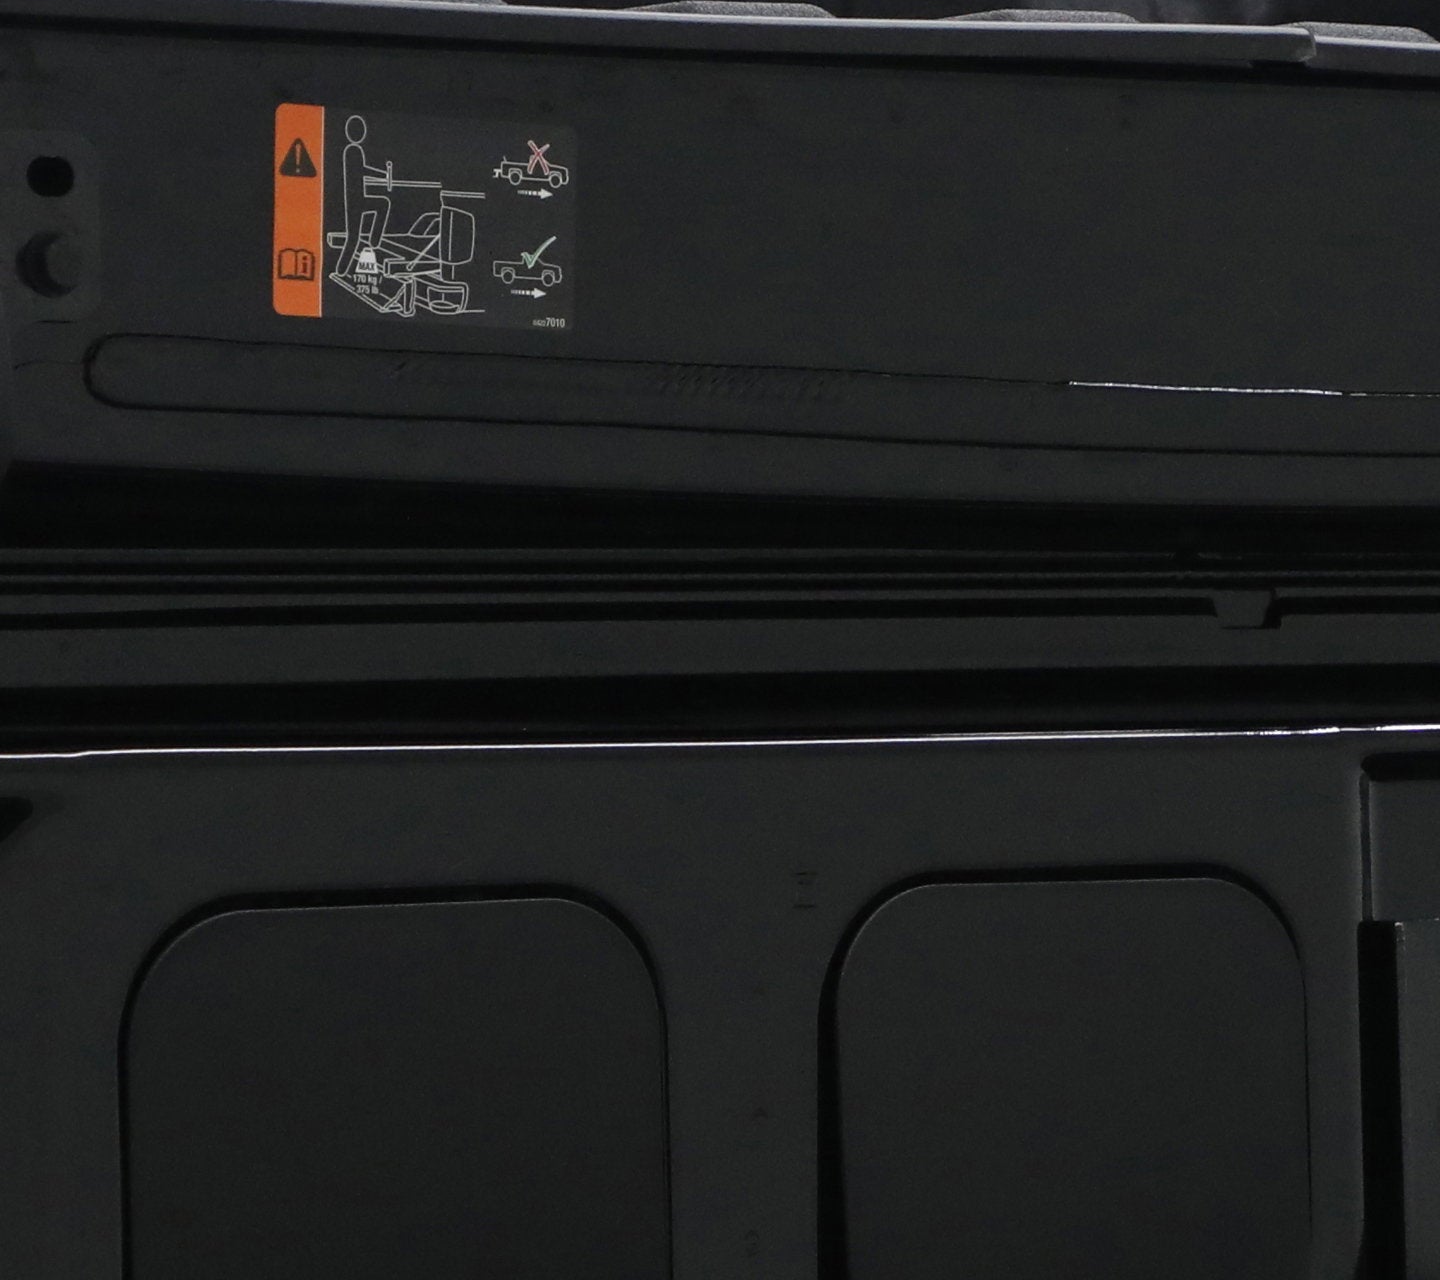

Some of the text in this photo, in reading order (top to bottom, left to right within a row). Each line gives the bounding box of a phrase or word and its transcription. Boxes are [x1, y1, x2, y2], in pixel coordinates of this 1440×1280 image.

[359, 262, 375, 271] MAX
[353, 274, 366, 283] 170
[368, 274, 377, 285] kg
[371, 285, 379, 294] lb
